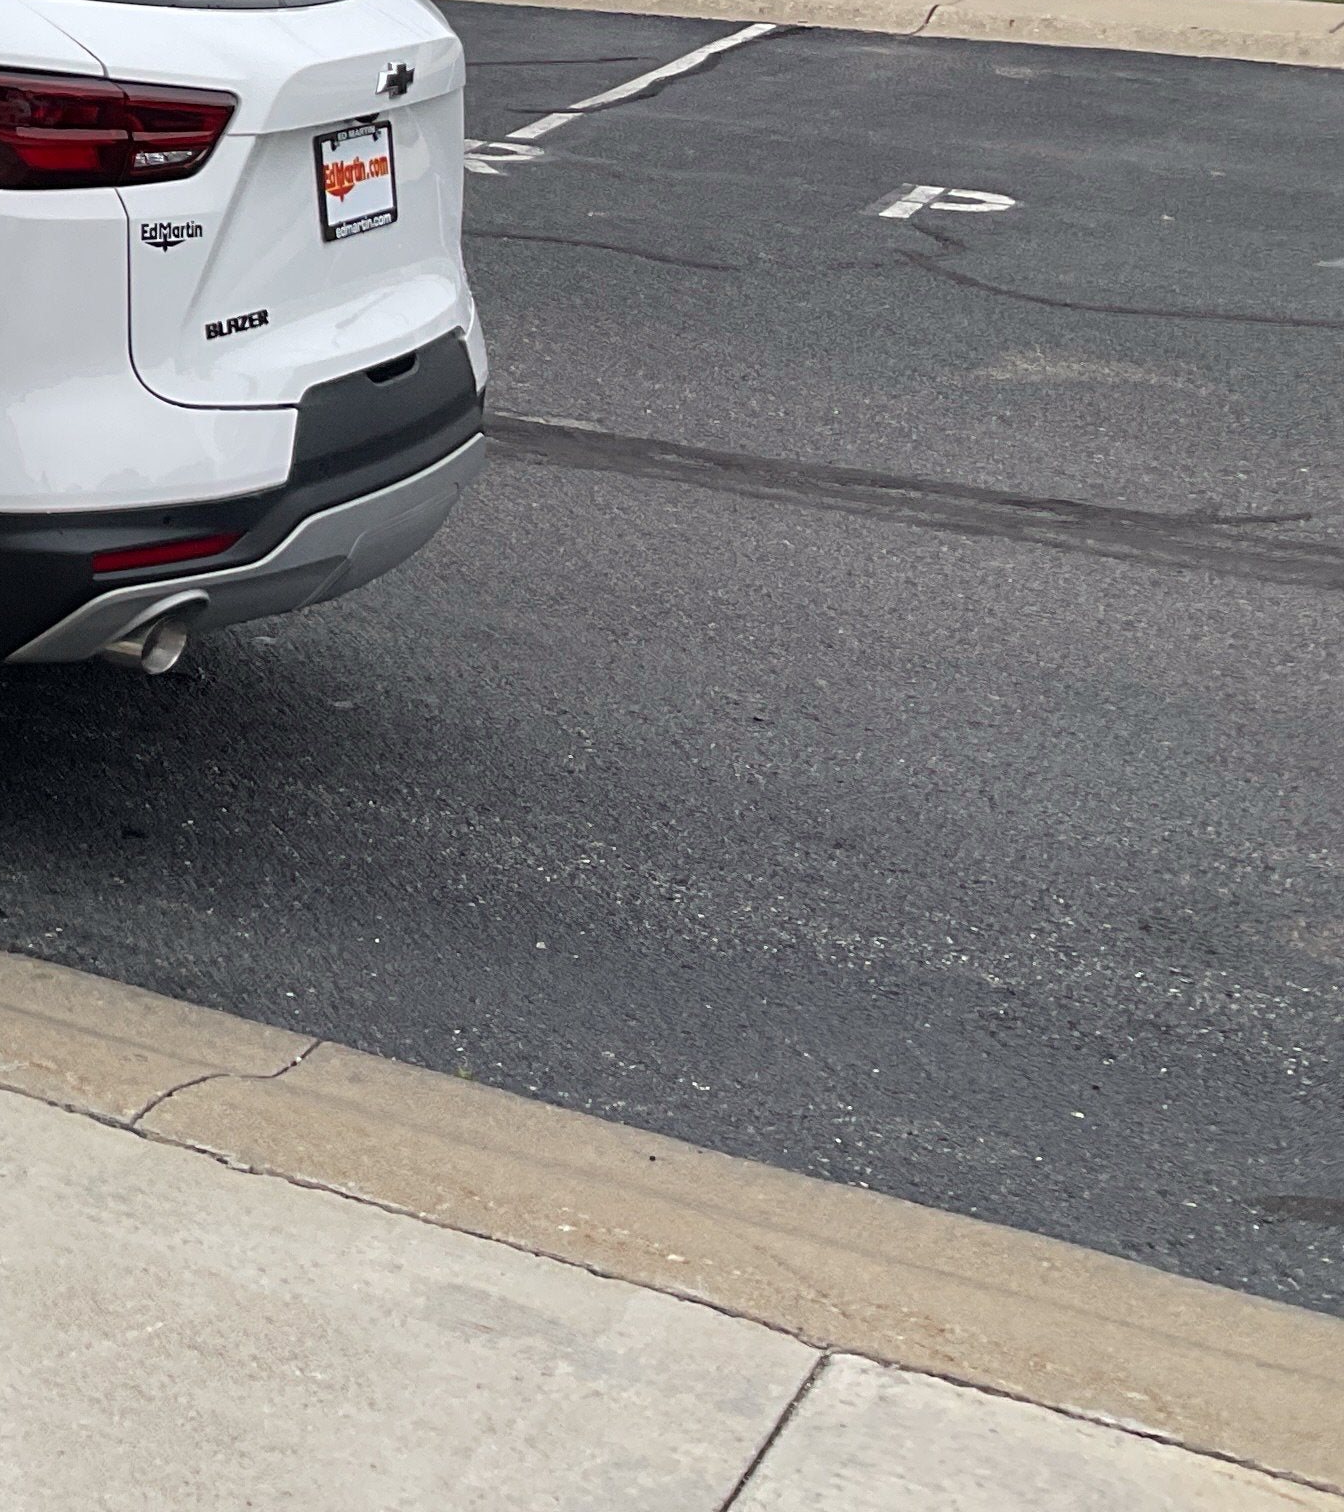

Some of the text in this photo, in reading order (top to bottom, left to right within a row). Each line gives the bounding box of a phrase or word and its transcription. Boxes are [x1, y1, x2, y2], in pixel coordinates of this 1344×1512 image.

[322, 155, 388, 190] EdMartin.com
[140, 220, 203, 244] EdMartin
[335, 214, 392, 239] edmartin.com
[205, 309, 269, 340] BLAZER
